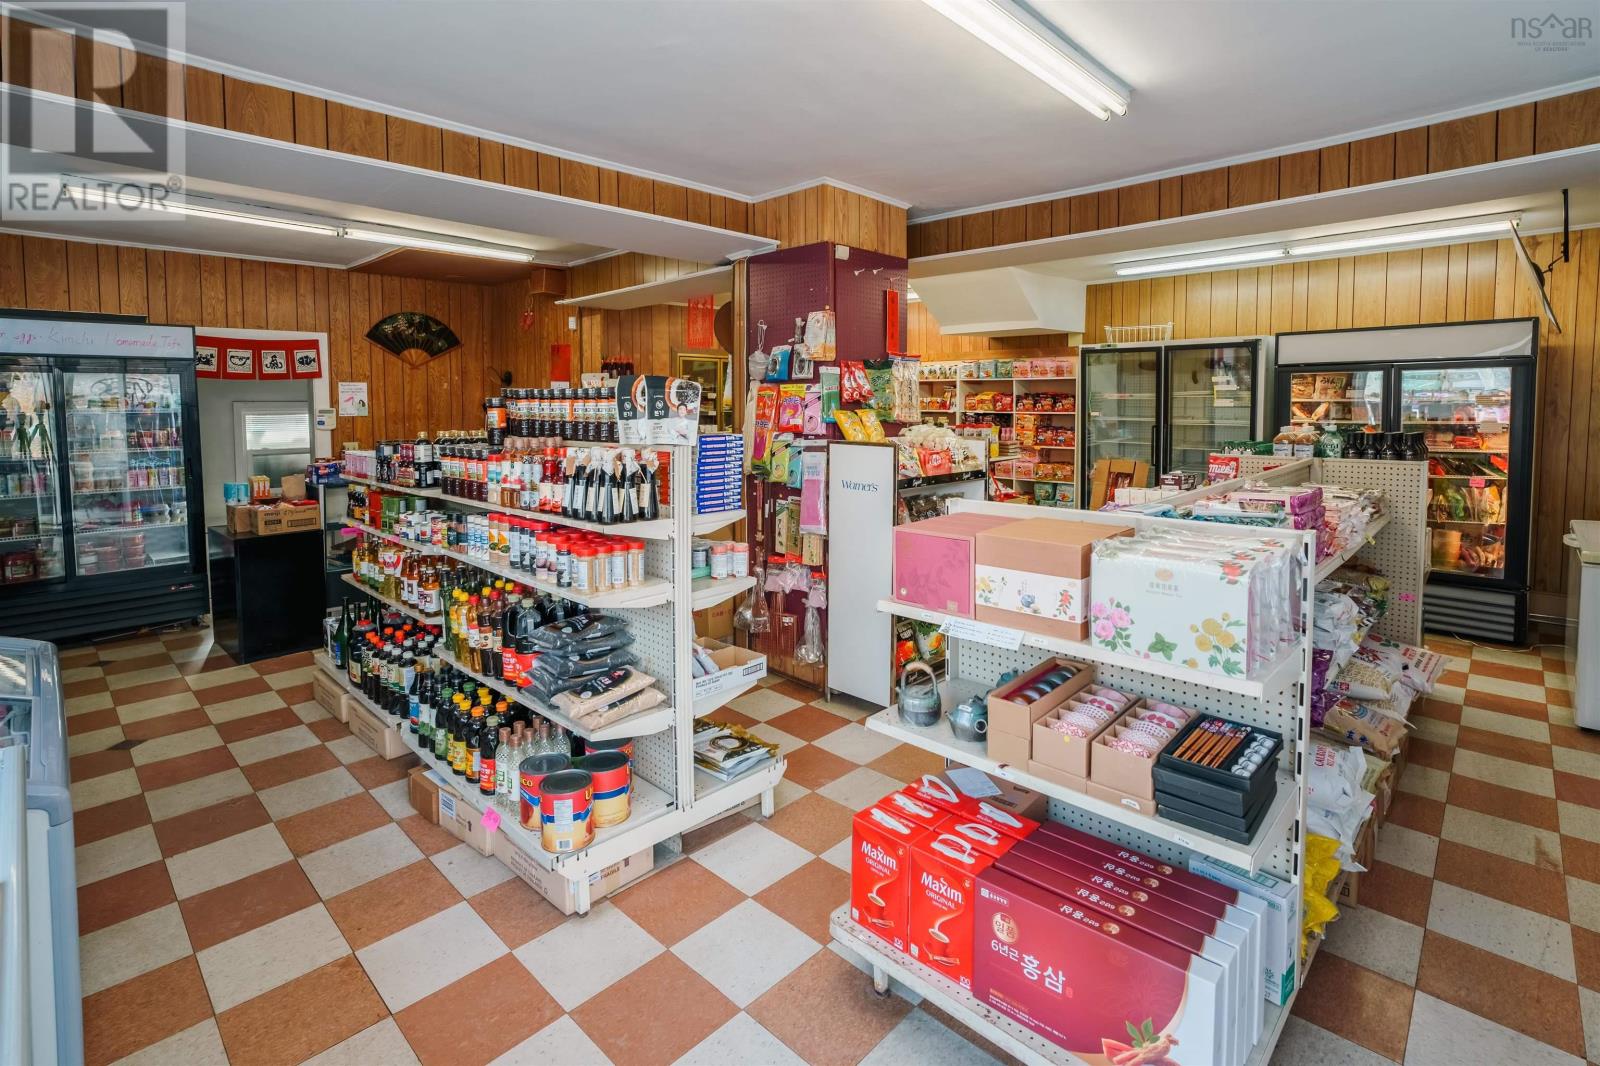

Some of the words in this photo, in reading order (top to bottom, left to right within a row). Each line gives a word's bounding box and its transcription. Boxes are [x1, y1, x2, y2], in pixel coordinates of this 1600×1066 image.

[861, 840, 898, 871] Maxim
[865, 857, 891, 876] ORIGINAL
[921, 871, 964, 904] Maxim
[925, 889, 957, 909] ORIGINAL
[991, 939, 1020, 962] 6년근
[1020, 953, 1066, 994] 홍삼
